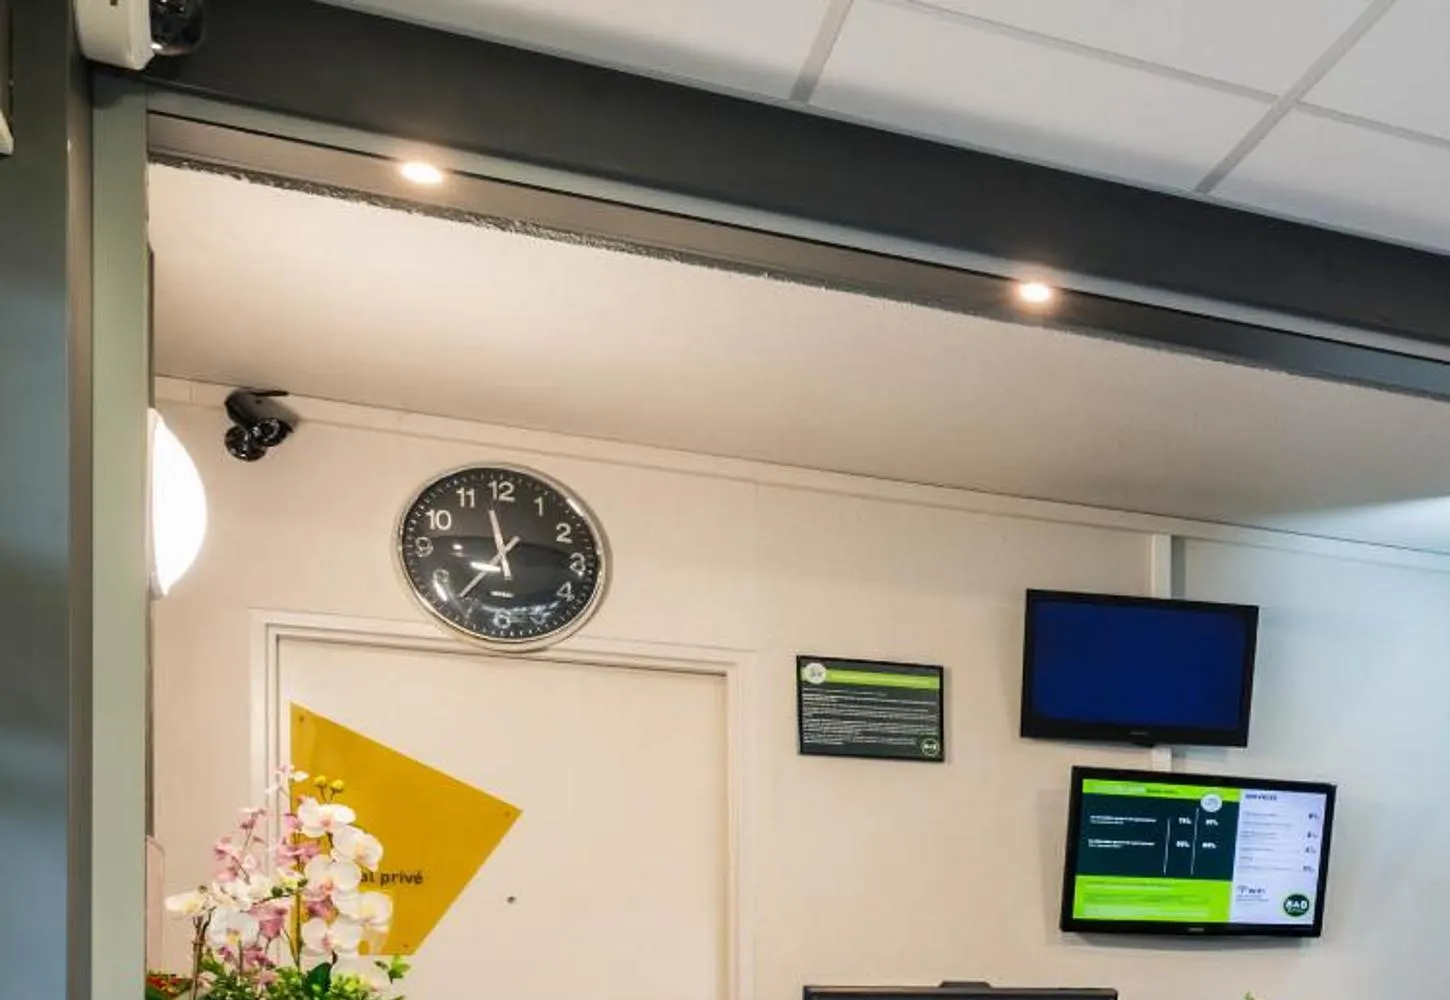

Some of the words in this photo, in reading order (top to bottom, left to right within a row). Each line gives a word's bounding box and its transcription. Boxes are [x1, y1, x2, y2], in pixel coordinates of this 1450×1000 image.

[456, 487, 476, 508] 11
[488, 480, 516, 502] 12
[533, 496, 544, 517] 1
[425, 509, 453, 531] 10
[556, 522, 573, 544] 2
[569, 552, 587, 577] 3
[556, 581, 576, 602] 4
[493, 607, 512, 630] 6
[380, 870, 424, 886] privé
